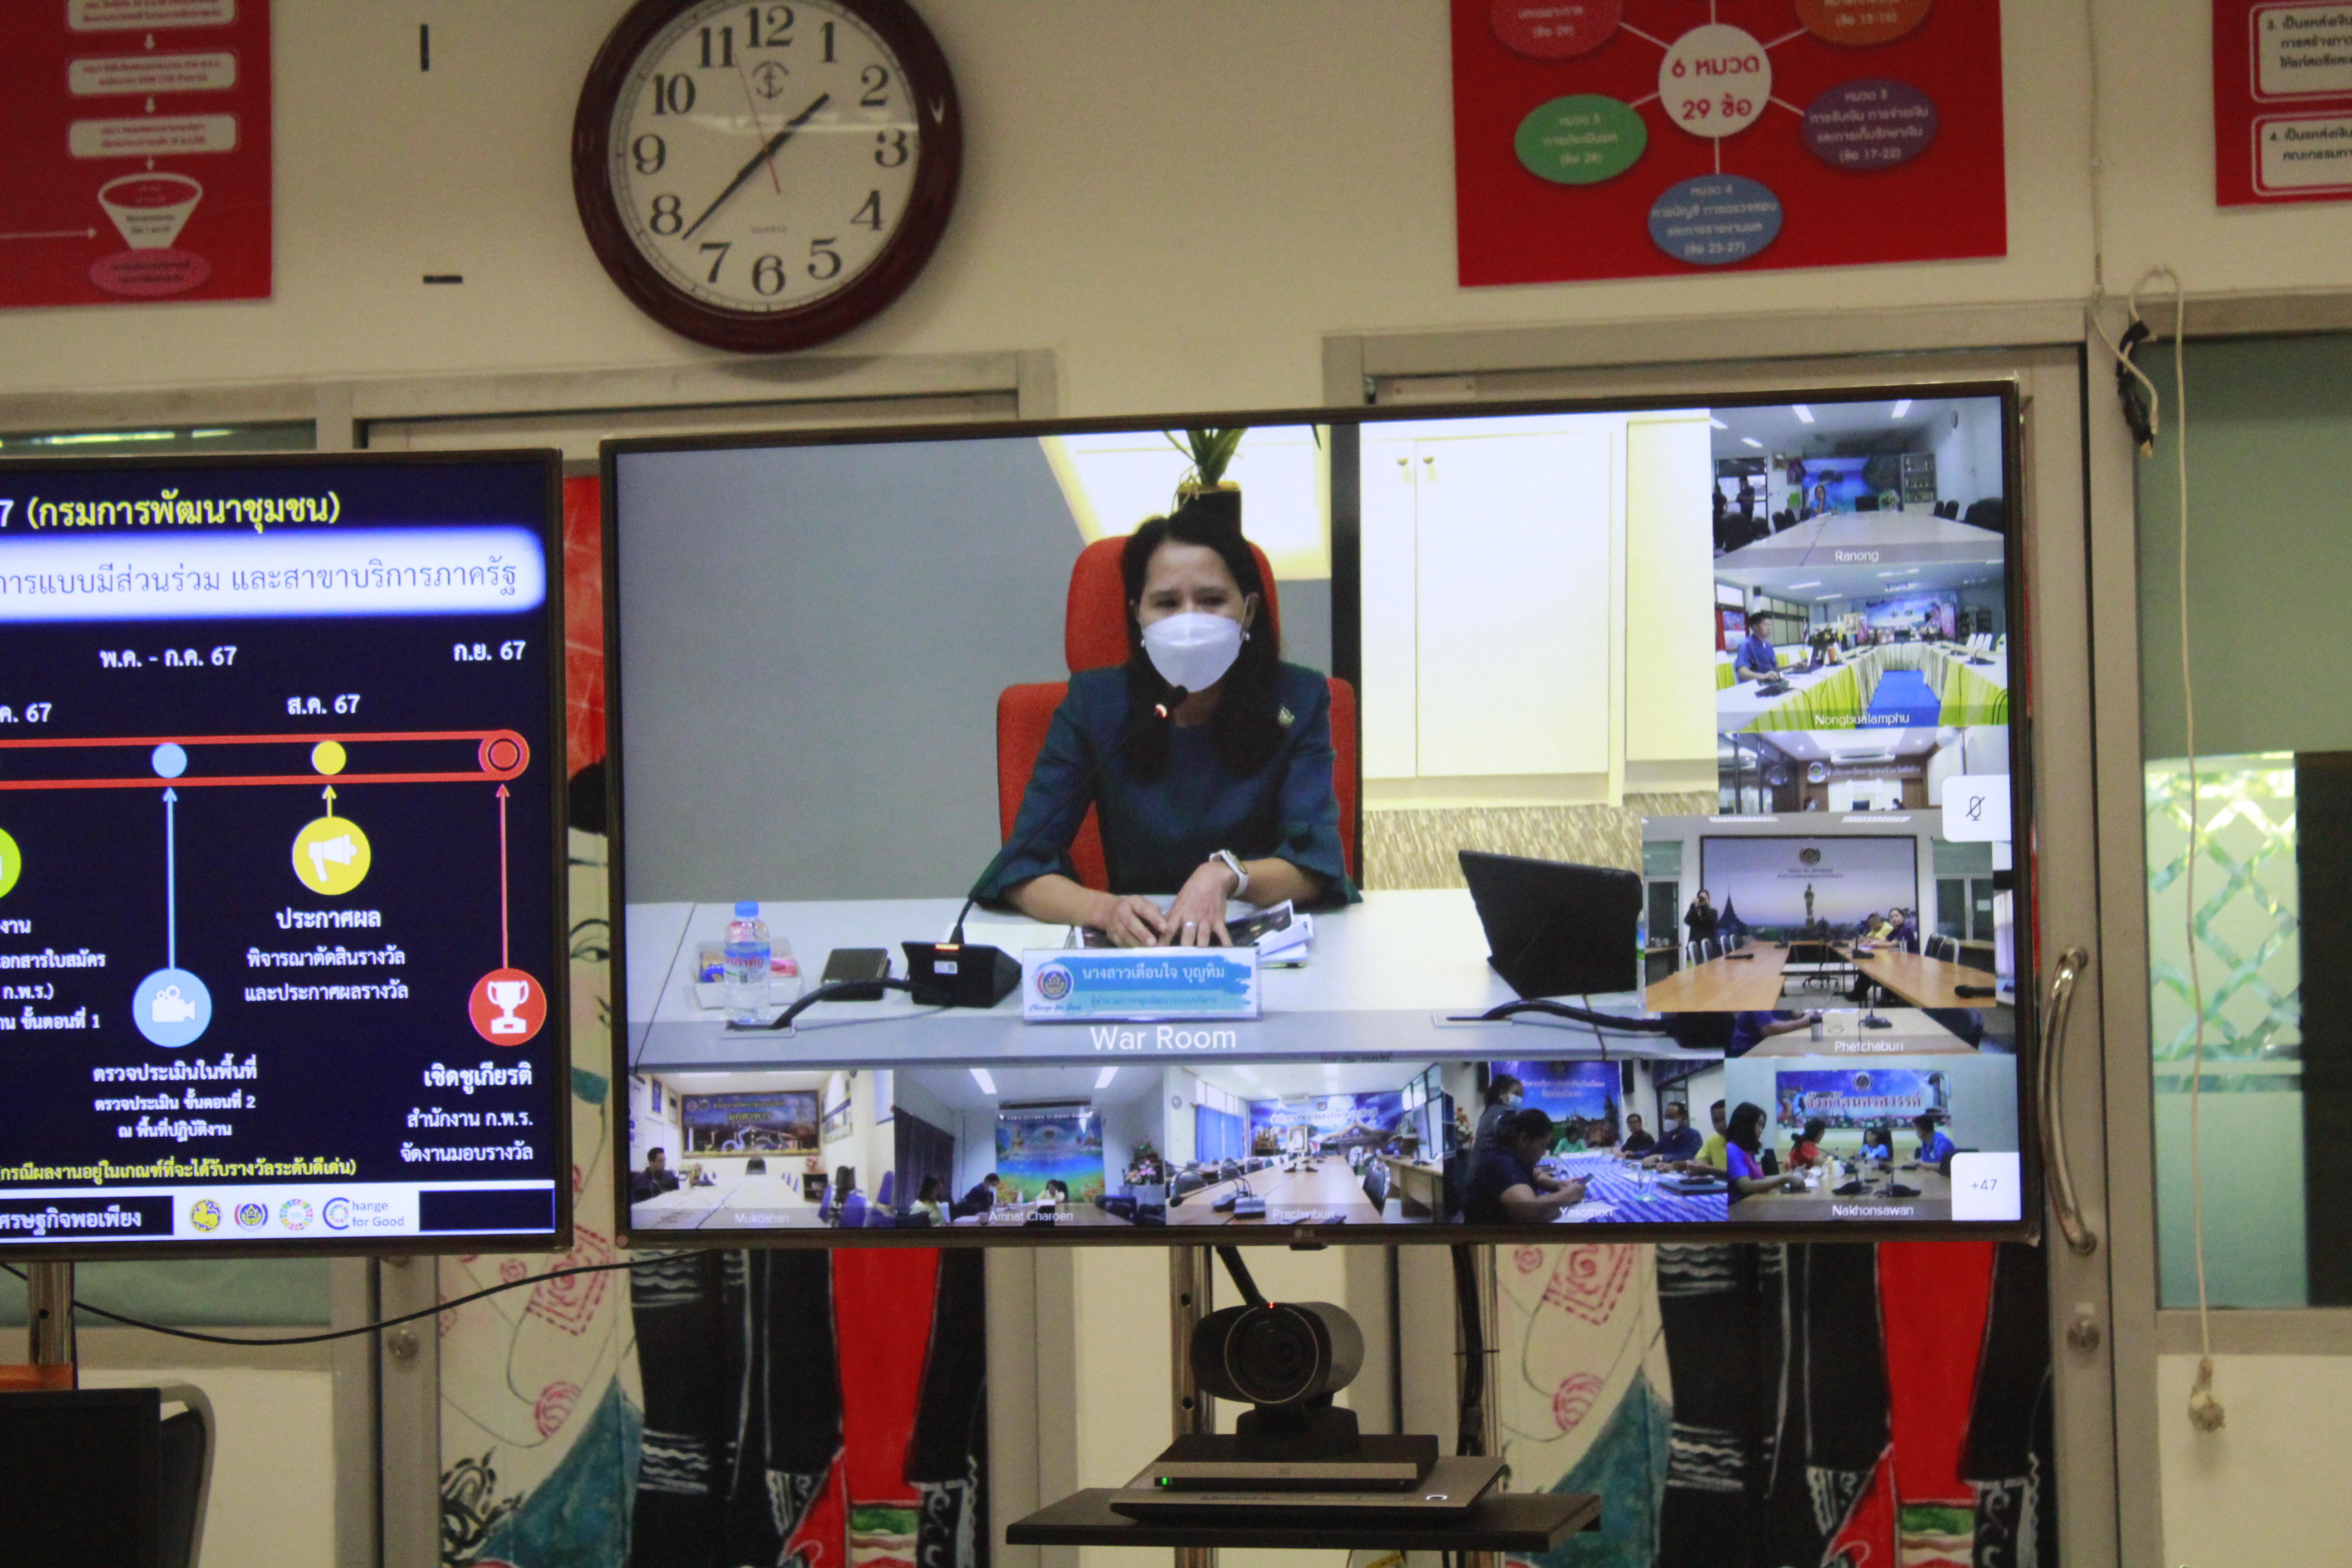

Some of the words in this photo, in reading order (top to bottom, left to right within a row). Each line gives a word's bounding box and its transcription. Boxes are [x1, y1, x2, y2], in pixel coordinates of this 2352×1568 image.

[745, 6, 794, 48] 12
[698, 27, 736, 68] 11
[820, 22, 838, 62] 1
[1672, 59, 1686, 78] 6
[1695, 55, 1760, 76] หมวด
[652, 73, 696, 115] 10
[860, 65, 889, 107] 2
[1682, 98, 1710, 120] 29
[1721, 92, 1752, 118] ข้อ
[632, 134, 666, 175] 9
[874, 128, 908, 167] 3
[650, 194, 683, 235] 8
[850, 190, 884, 230] 4
[699, 243, 731, 283] 7
[808, 238, 842, 279] 5
[752, 255, 786, 295] 6
[27, 489, 340, 534] (กรมการพัฒนาชุมชน)
[1835, 550, 1879, 562] Ranong
[230, 554, 518, 596] และสาขาบริการภาครัฐ
[99, 648, 142, 667] พ.ค.
[164, 649, 203, 666] ก.ค.
[211, 647, 237, 666] 67
[454, 642, 492, 662] ก.ย.
[500, 641, 527, 660] 67
[24, 702, 52, 722] 67
[287, 697, 327, 715] ส.ค.
[334, 695, 361, 714] 67
[1815, 714, 1910, 727] Nongbualamphu
[275, 907, 382, 929] ประกาศผล
[0, 947, 106, 969] อกสารใบสมัคร
[247, 944, 406, 967] พิจารณาตัดสินรางวัล
[1, 982, 54, 1000] ก.พ.ร.)
[244, 978, 408, 1001] และประกาศผลรางวัล
[20, 1005, 86, 1030] ขั้นตอนที่
[91, 1014, 101, 1029] 1
[1090, 1026, 1147, 1051] War
[1157, 1025, 1237, 1049] Room
[1834, 1040, 1904, 1052] Phetchaburi
[92, 1053, 257, 1082] ตรวจประเมินในพื้นที่
[423, 1061, 533, 1094] เชิดชูเกียรติ
[93, 1093, 179, 1111] ตรวจประเมิน
[183, 1088, 242, 1110] ขั้นตอนที่
[245, 1095, 256, 1109] 2
[117, 1125, 132, 1138] ณ
[136, 1116, 232, 1142] พื้นที่ปฏิบัติงาน
[407, 1107, 480, 1128] สำนักงาน
[485, 1112, 534, 1127] ก.พ.ร.
[399, 1140, 534, 1162] จัดงานมอบรางวัล
[0, 1158, 356, 1185] กรณีผลงานอยู่ในเกณฑ์ที่จะได้รับรางวัลระดับดีเด่น)
[1971, 1180, 1997, 1191] +47
[352, 1217, 369, 1227] for
[372, 1216, 405, 1227] Good
[735, 1213, 789, 1223] Mukdahan
[989, 1212, 1024, 1221] Amnat
[1027, 1211, 1074, 1221] Charoen
[1272, 1209, 1335, 1220] Prachinburi
[1559, 1206, 1613, 1217] Yasothon
[1832, 1205, 1914, 1216] Nakhonsawan
